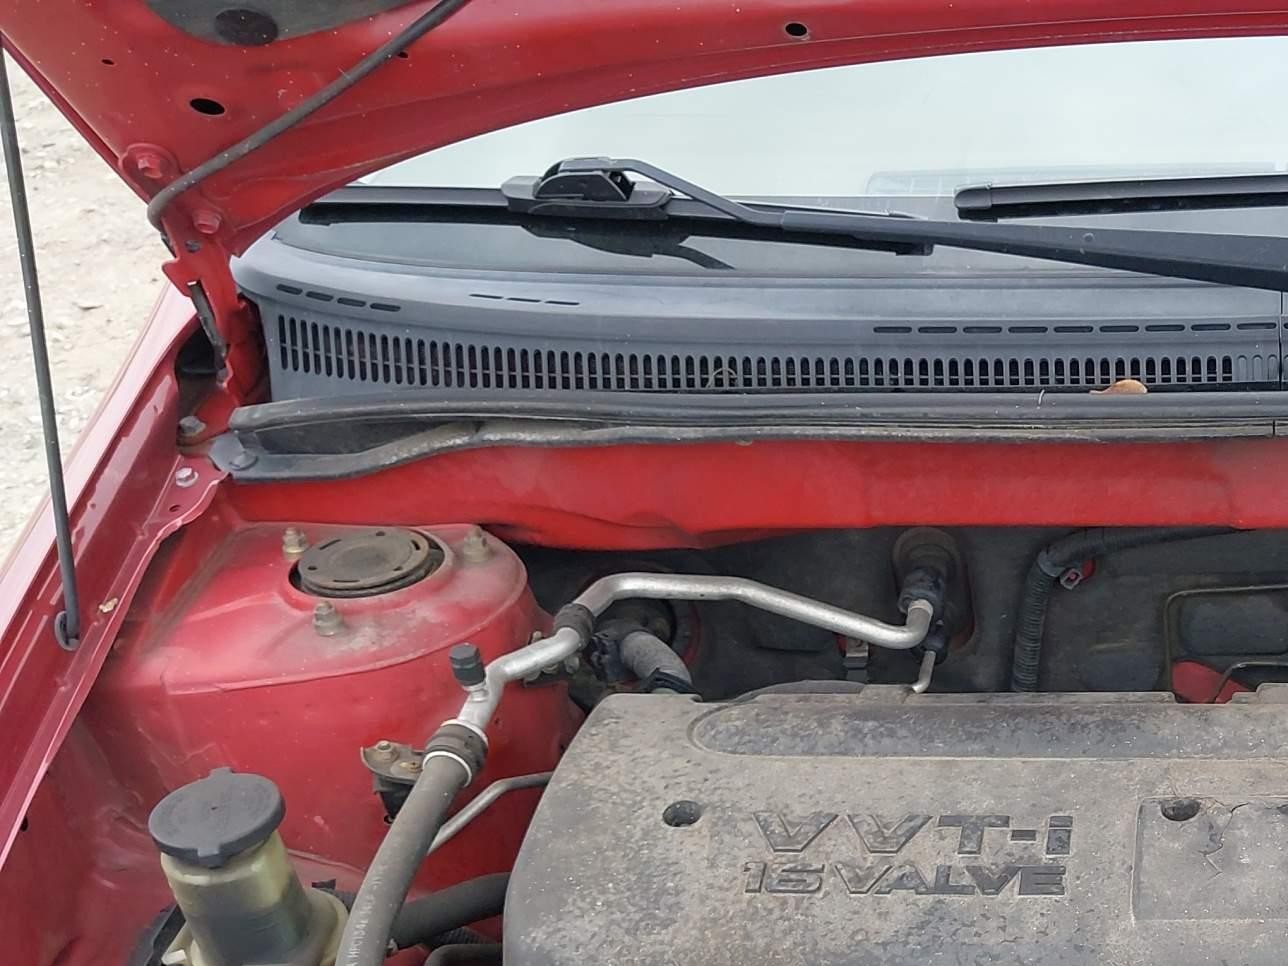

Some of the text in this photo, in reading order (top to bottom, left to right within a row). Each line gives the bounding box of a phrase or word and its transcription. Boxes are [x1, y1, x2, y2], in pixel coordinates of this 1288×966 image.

[752, 812, 1073, 855] VVT-i
[743, 862, 1066, 896] 16 VALVE
